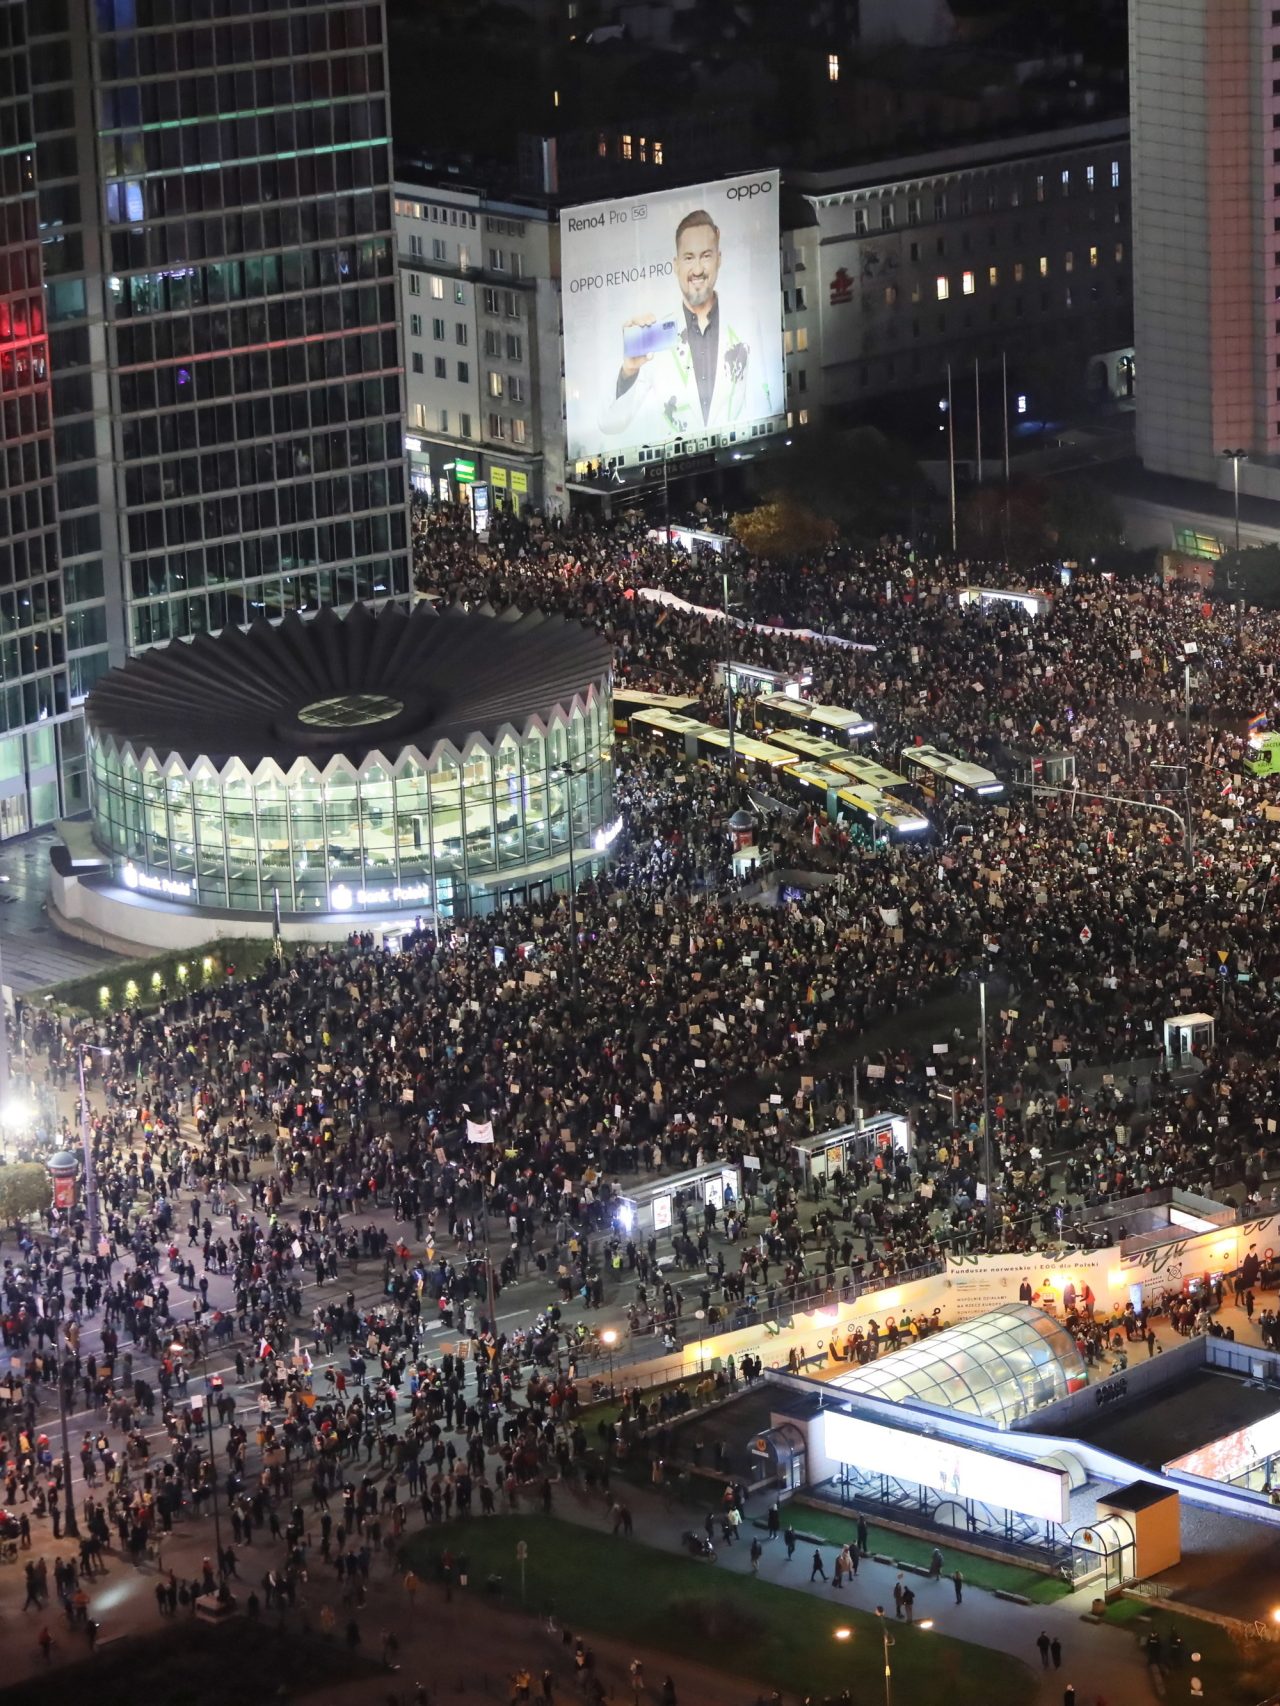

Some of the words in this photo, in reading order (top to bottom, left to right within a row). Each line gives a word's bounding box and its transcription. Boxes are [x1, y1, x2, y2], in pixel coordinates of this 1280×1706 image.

[726, 181, 772, 201] oppo
[568, 213, 605, 232] Reno4
[609, 210, 628, 225] Pro
[633, 207, 647, 218] 5G
[570, 275, 604, 294] OPPO
[606, 267, 647, 287] RENO4
[649, 261, 673, 279] PRO
[139, 873, 161, 890] Bank
[357, 888, 391, 904] Bank
[990, 1265, 1031, 1273] norweskie
